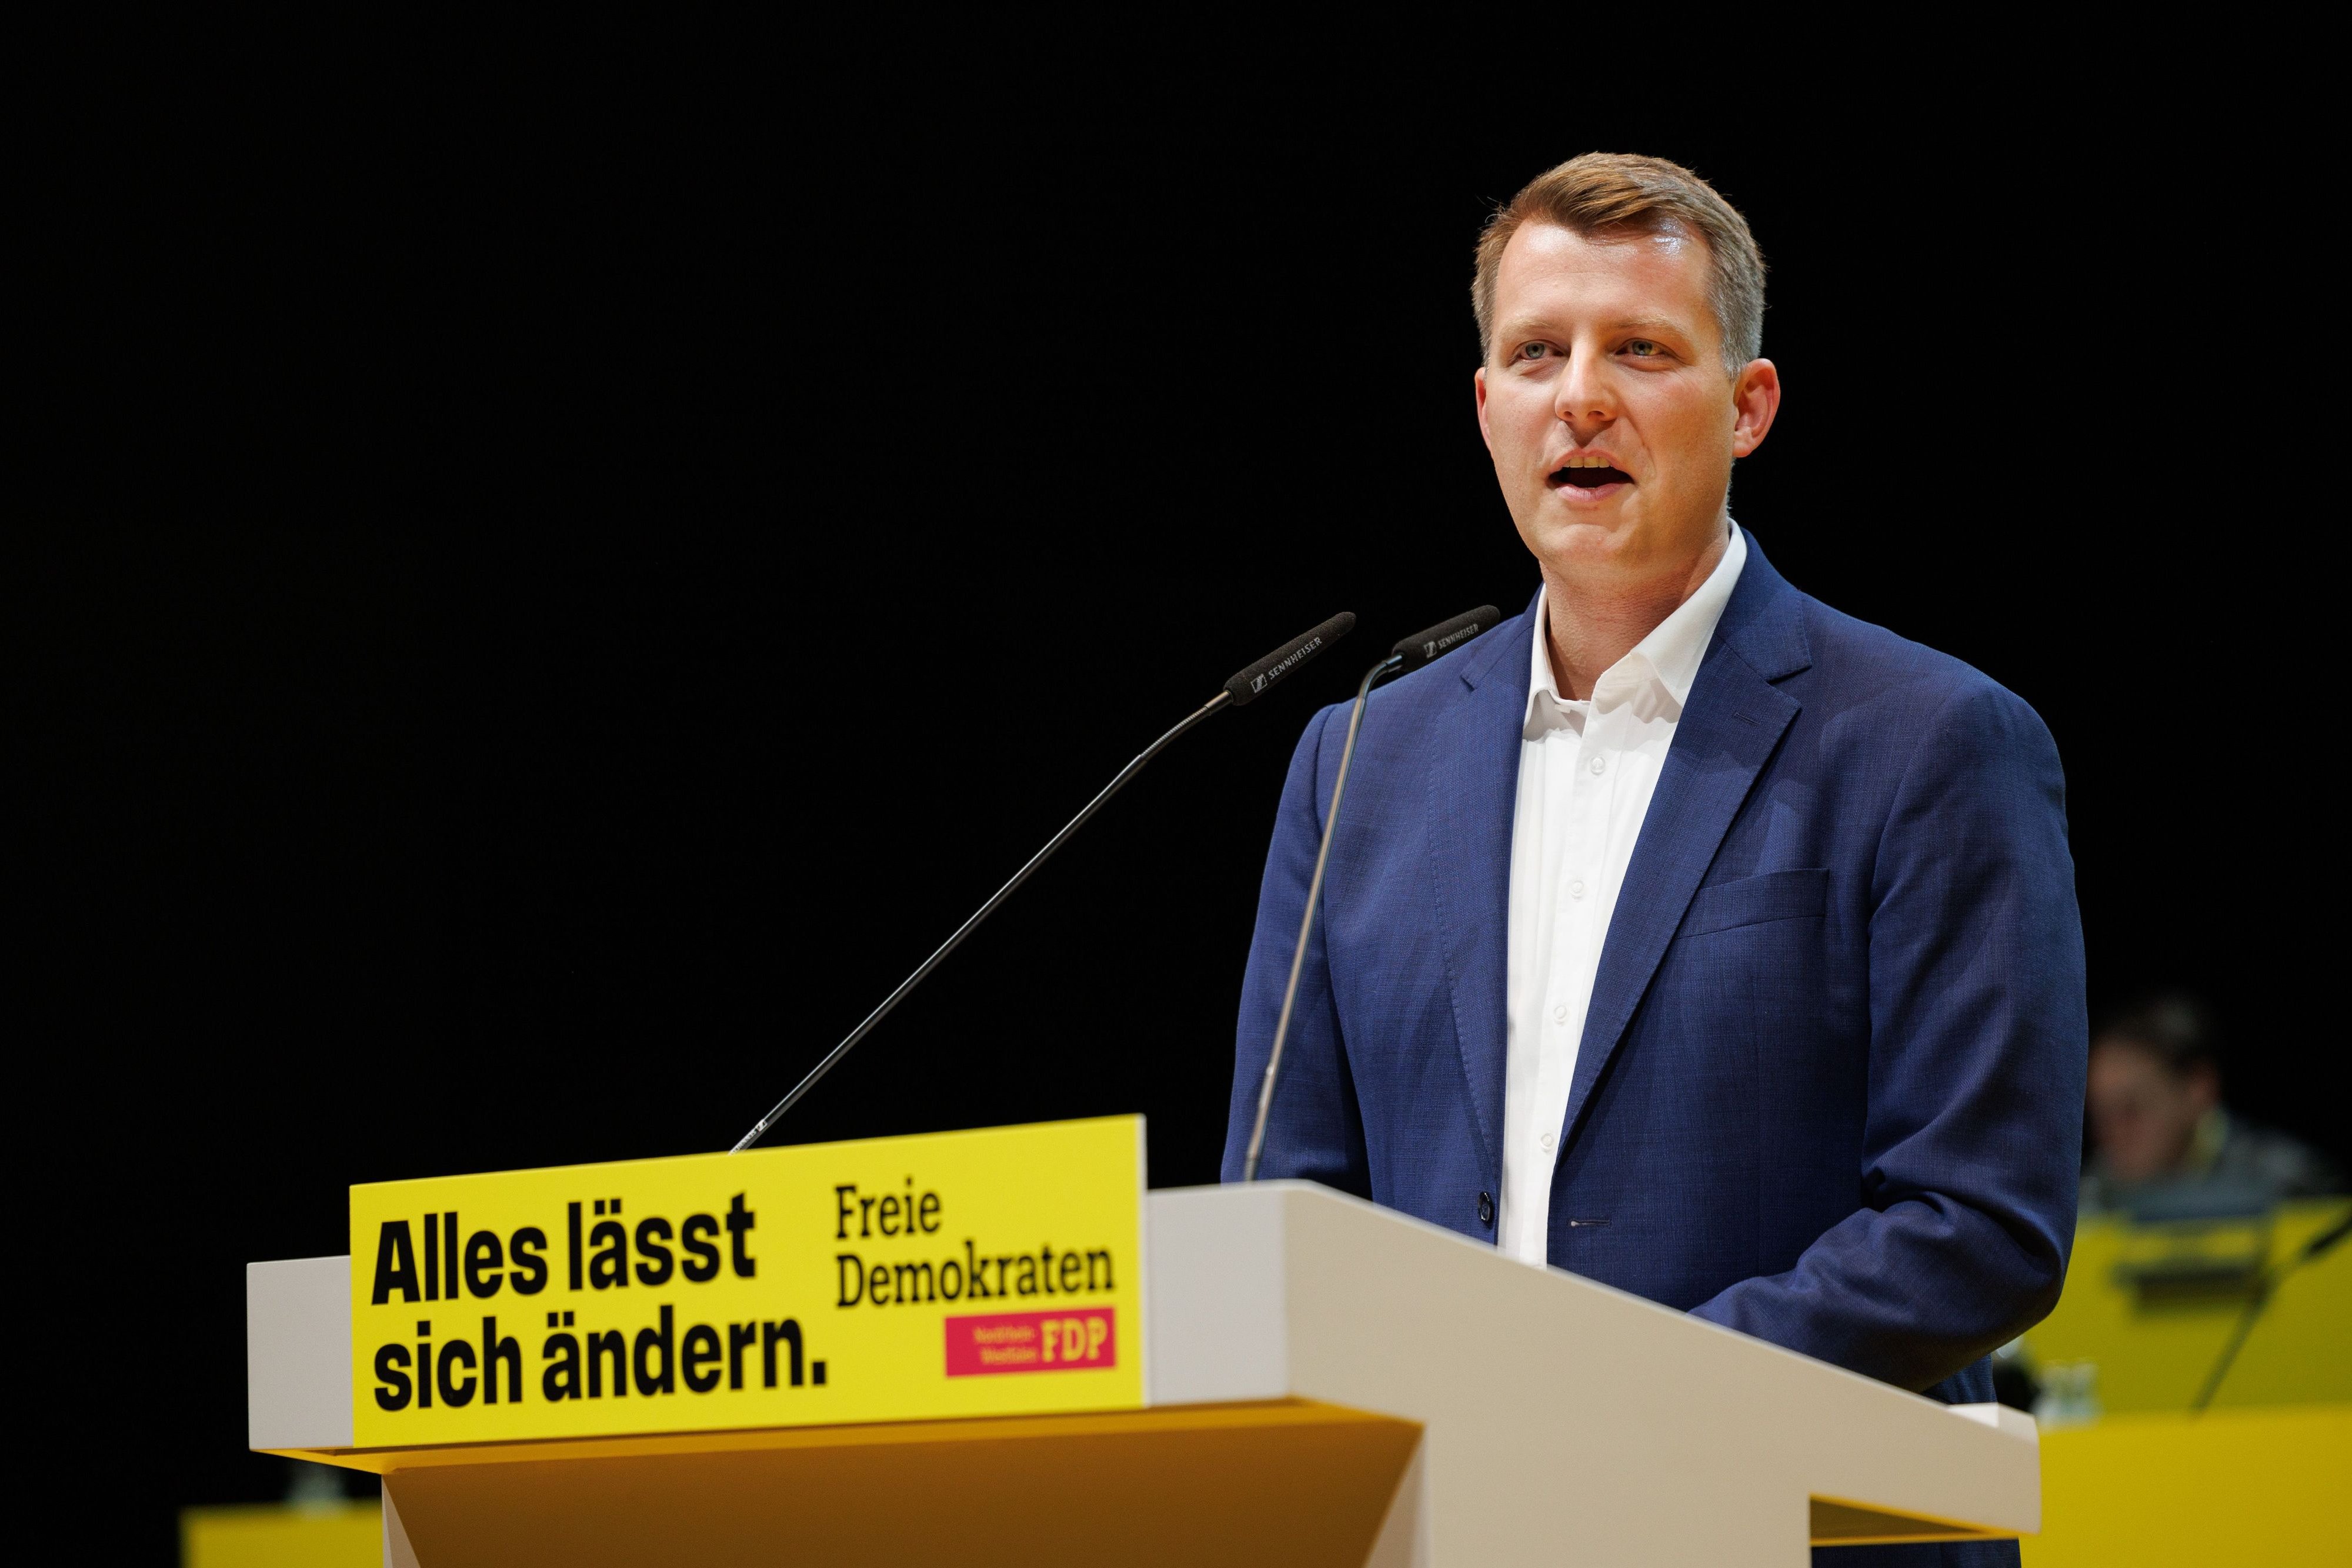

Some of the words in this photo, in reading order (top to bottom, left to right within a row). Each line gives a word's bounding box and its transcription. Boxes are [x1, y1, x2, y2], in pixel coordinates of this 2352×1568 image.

[1268, 636, 1322, 680] SENNHEISER
[1438, 623, 1479, 649] SENNHEISER
[834, 1176, 942, 1240] Freie
[371, 1210, 549, 1306] Alles
[567, 1192, 757, 1292] lässt
[836, 1239, 1115, 1309] Demokraten
[373, 1315, 523, 1413] sich
[541, 1303, 827, 1403] ändern.
[1040, 1316, 1108, 1363] FDP
